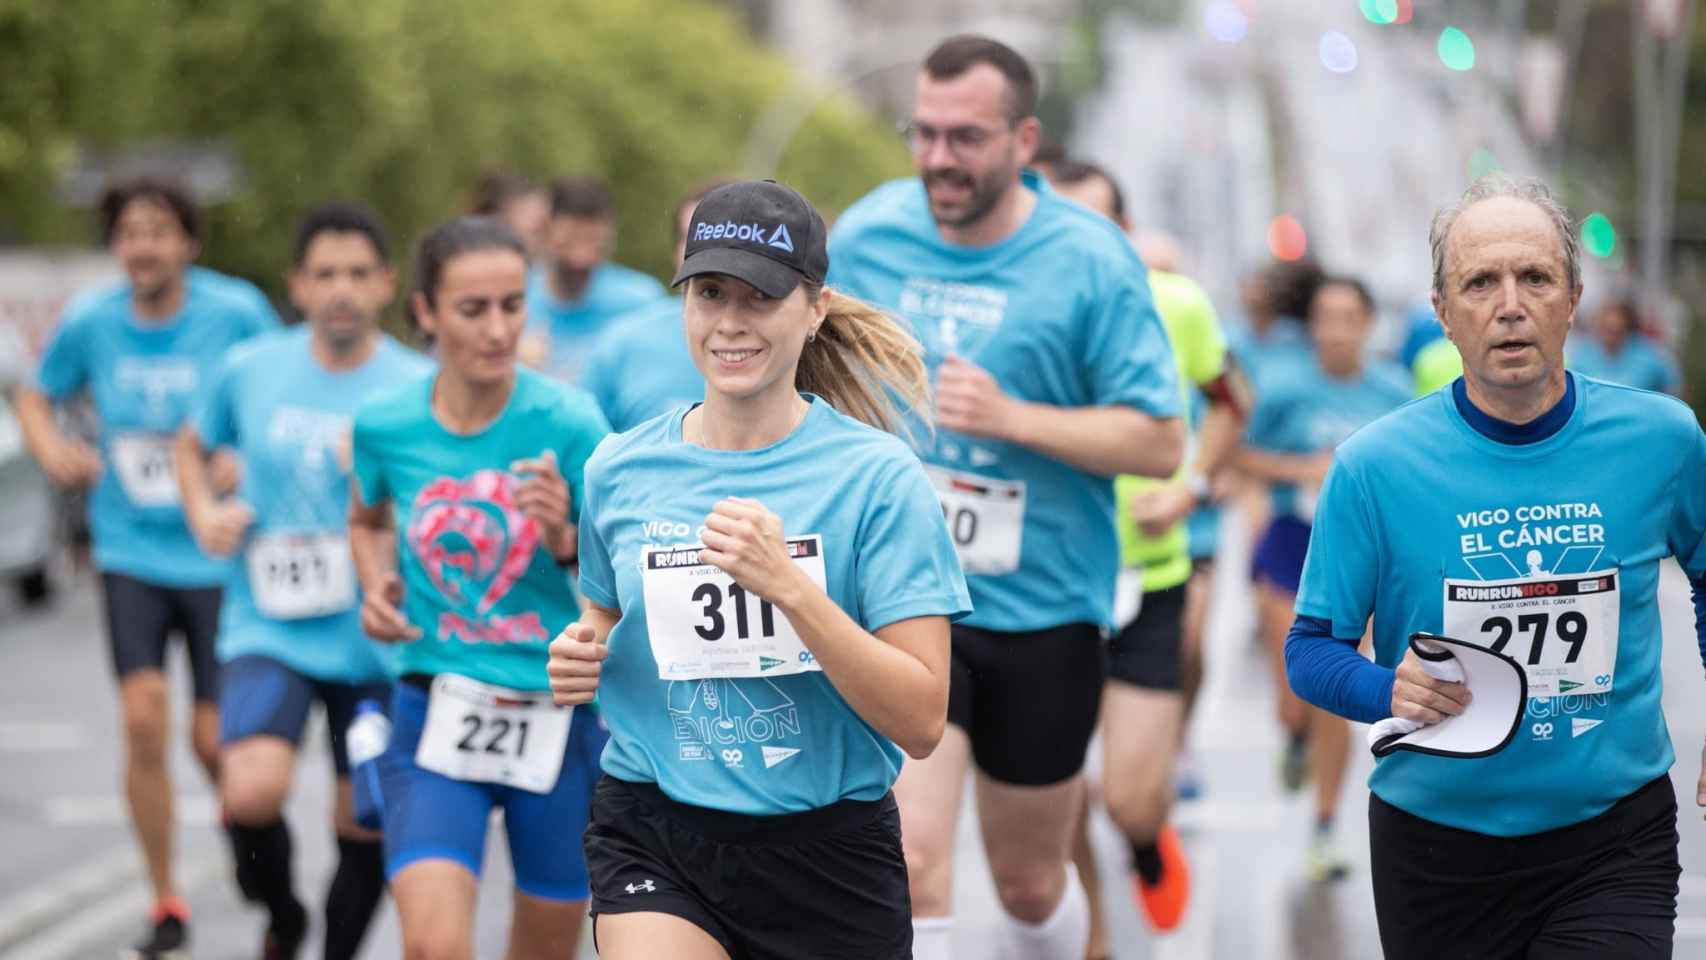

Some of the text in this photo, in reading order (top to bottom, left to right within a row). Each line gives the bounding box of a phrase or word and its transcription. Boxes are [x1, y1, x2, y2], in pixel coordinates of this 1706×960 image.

[694, 221, 767, 245] Reebok
[641, 520, 691, 538] VIGO
[1457, 503, 1602, 529] VIGO CONTRA
[1460, 523, 1605, 554] EL CÁNCER
[1480, 611, 1588, 666] 279
[457, 714, 528, 758] 221
